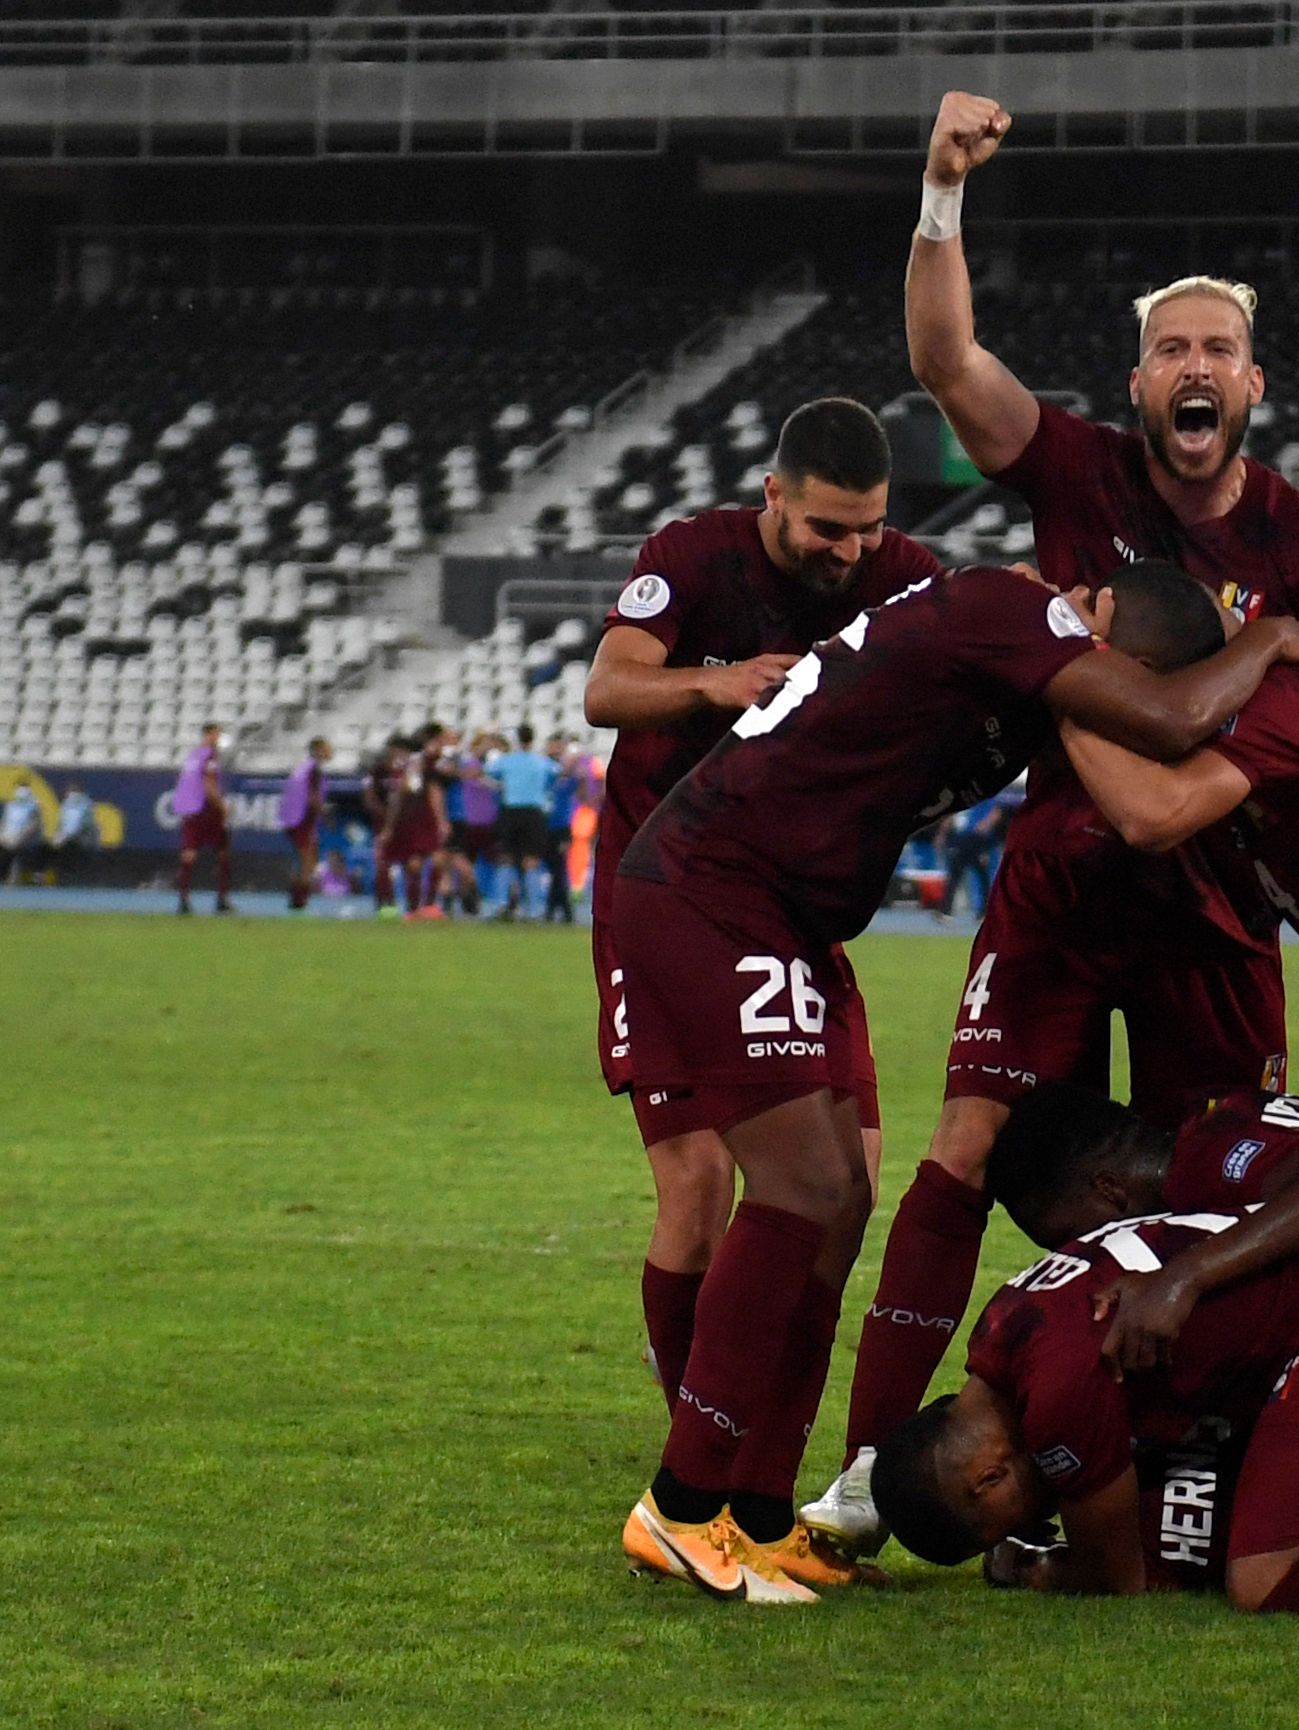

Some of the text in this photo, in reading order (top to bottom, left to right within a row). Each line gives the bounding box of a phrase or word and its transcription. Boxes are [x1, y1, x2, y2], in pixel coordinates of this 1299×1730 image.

[736, 956, 827, 1034] 26
[962, 953, 998, 1021] 4
[747, 1042, 826, 1058] GIVOVA
